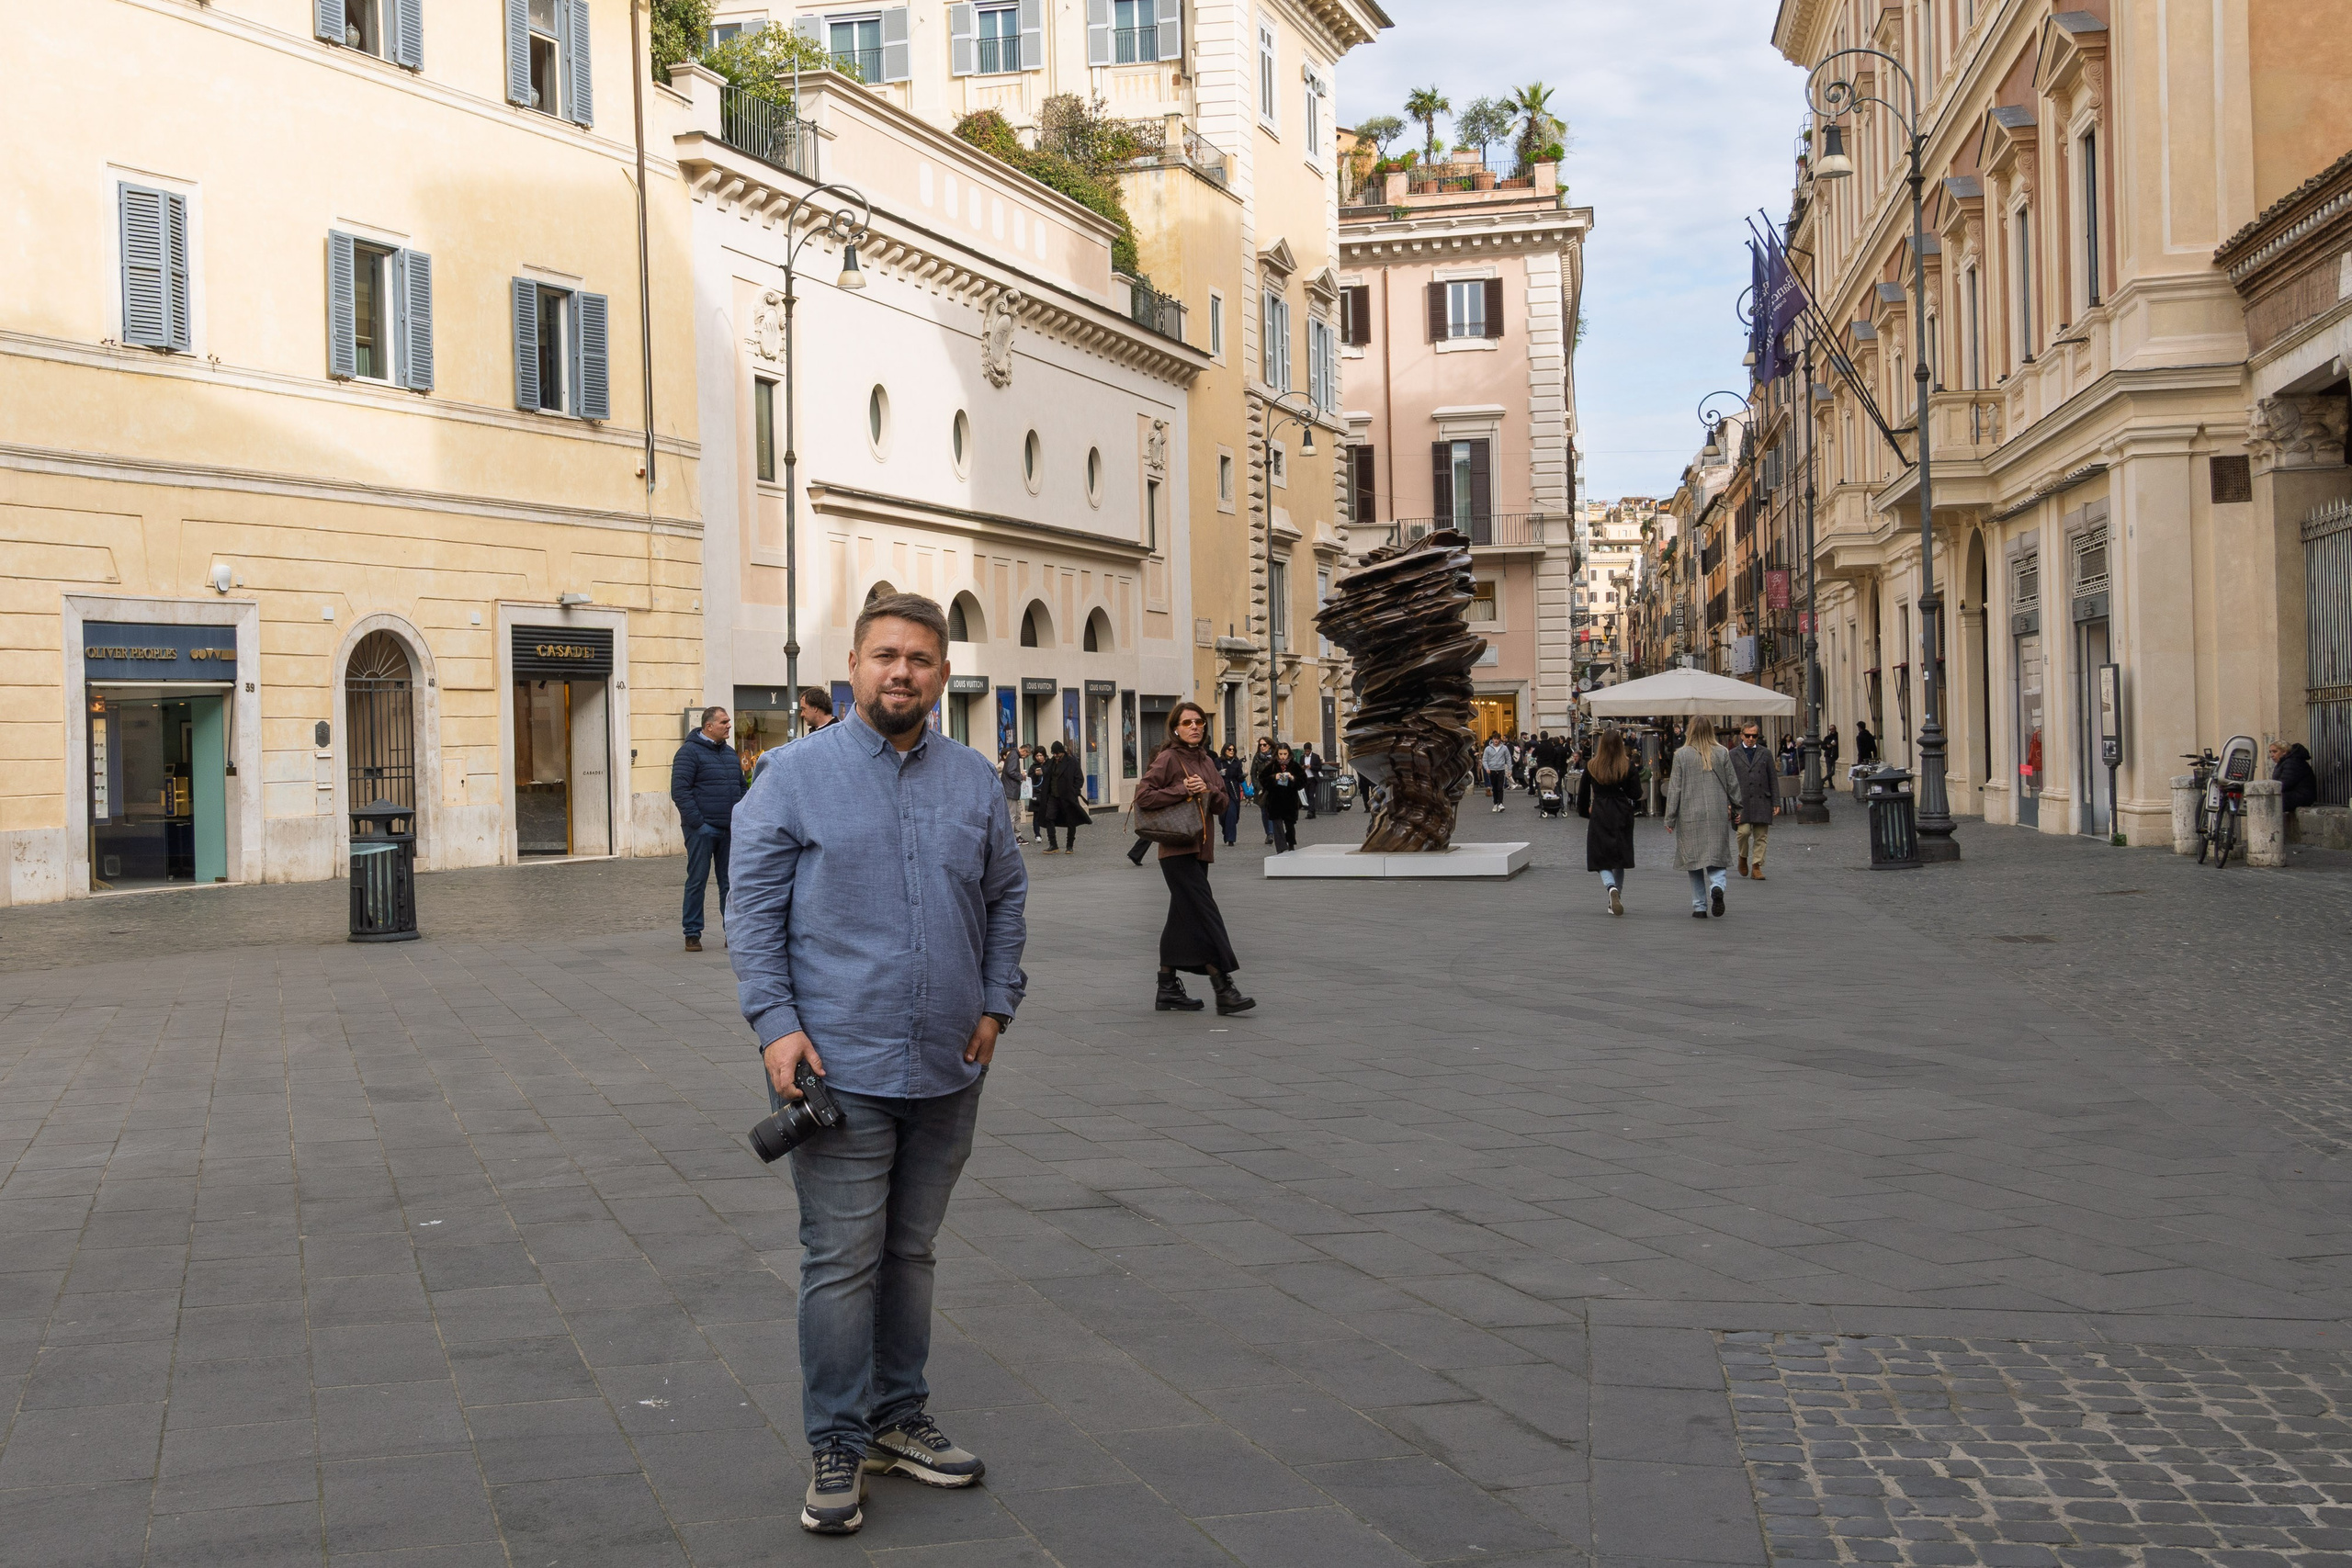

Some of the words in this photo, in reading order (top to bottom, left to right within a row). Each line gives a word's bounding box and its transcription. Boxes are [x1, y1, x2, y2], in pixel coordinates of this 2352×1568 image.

[85, 647, 128, 659] OLIVER
[130, 648, 177, 660] PEOPLES
[537, 644, 595, 659] CASADEI
[245, 682, 255, 693] 39
[954, 680, 966, 688] LOUIS
[1026, 682, 1037, 690] LOUIS
[877, 1438, 934, 1464] GOODYEAR
